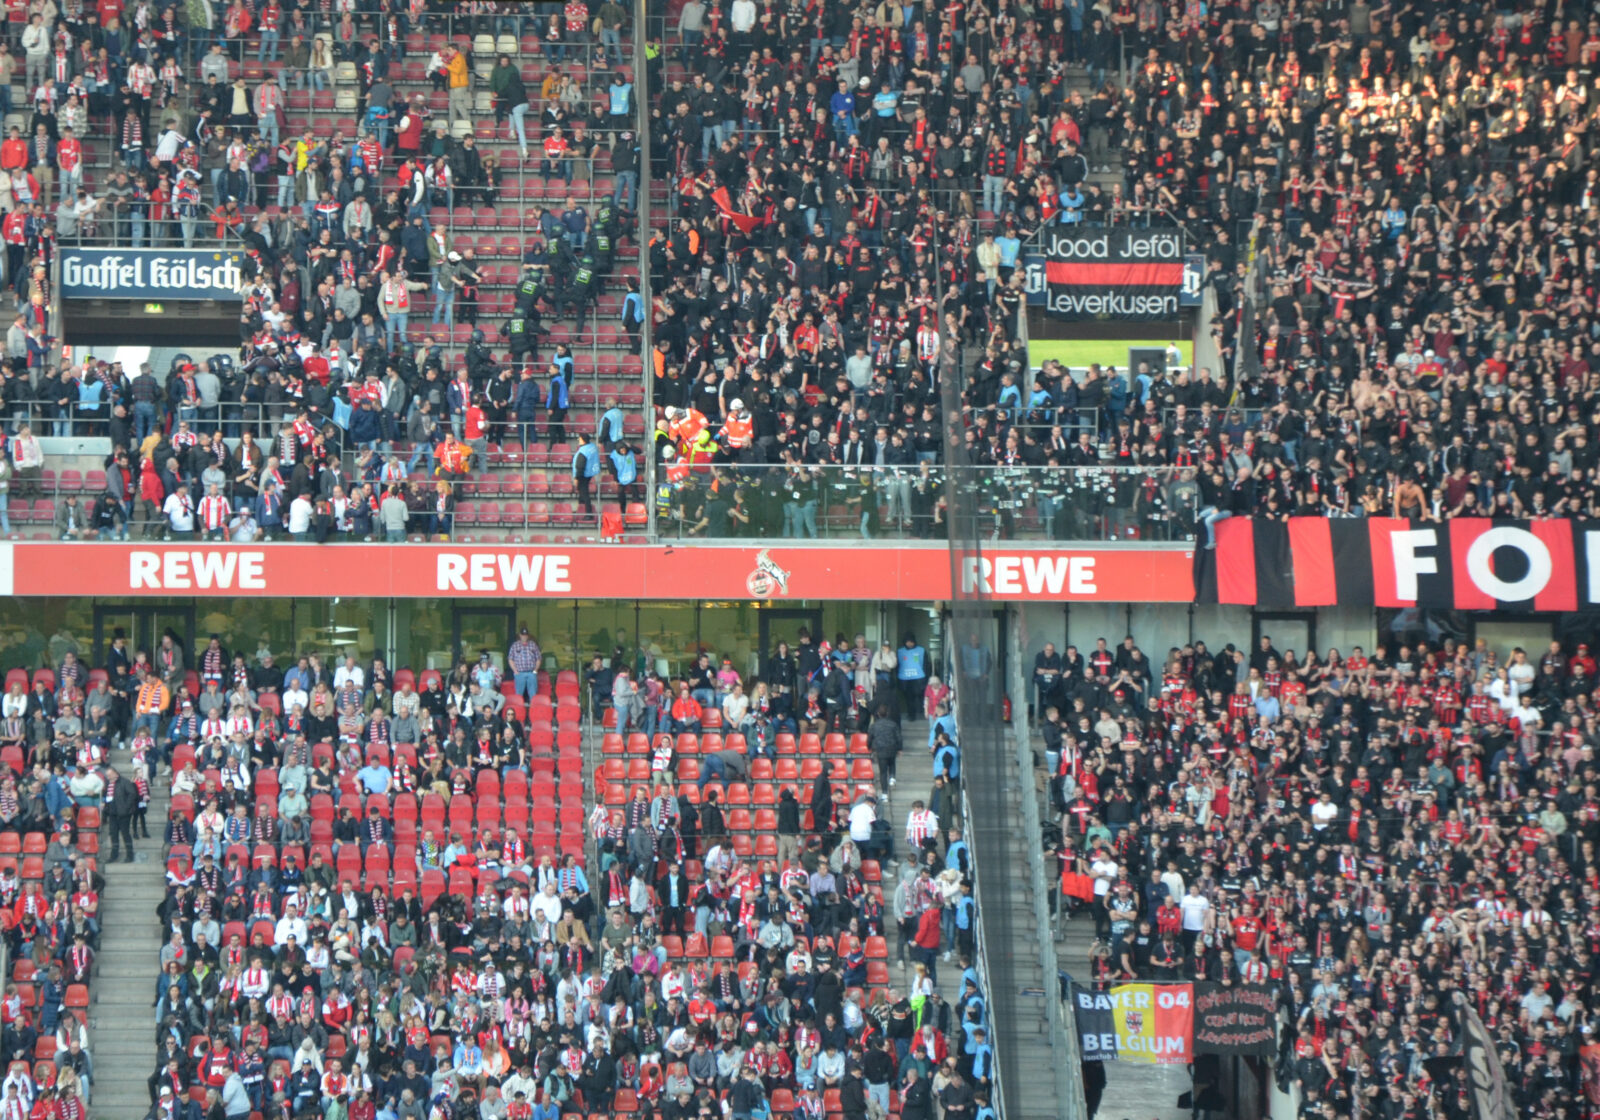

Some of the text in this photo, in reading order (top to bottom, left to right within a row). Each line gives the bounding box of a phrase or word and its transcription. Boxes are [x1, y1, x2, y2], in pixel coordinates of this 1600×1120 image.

[1047, 234, 1180, 258] Jood Jeföl
[63, 256, 242, 294] Gaffel Kölsch
[1047, 287, 1178, 314] Leverkusen
[129, 551, 266, 589] REWE
[436, 553, 572, 592] REWE
[962, 556, 1097, 594] REWE
[1390, 526, 1600, 604] FO
[1078, 990, 1150, 1011] BAYER
[1158, 991, 1191, 1010] 04
[1082, 1032, 1186, 1055] BELGIUM
